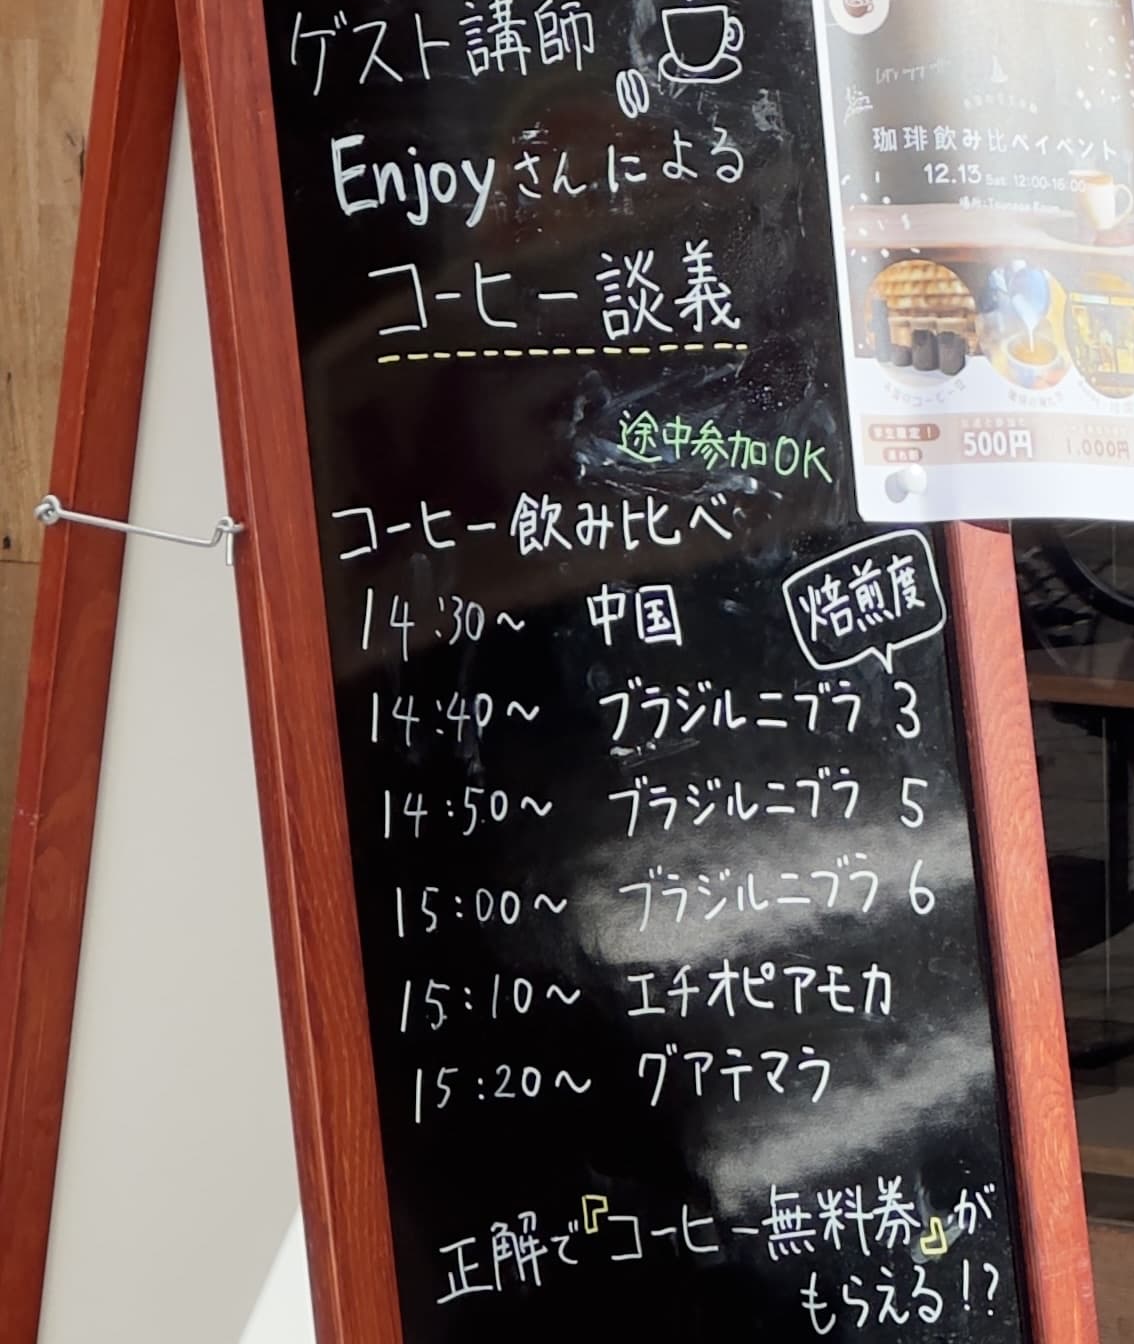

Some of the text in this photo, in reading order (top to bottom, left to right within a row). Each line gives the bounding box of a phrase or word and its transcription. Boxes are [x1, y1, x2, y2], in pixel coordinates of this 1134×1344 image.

[871, 124, 1118, 161] 珈琲飲み比べイベント
[922, 162, 982, 185] 12.13
[331, 127, 743, 227] Enjoy さんによる
[368, 240, 740, 340] コーヒー談義
[616, 410, 833, 484] 途中参加OK
[962, 429, 1033, 458] 500円
[332, 493, 733, 559] コーヒー飲み比べ
[587, 584, 682, 646] 中国
[802, 553, 926, 642] 焙煎度
[599, 677, 860, 741] ブラジルニブラ
[894, 682, 920, 738] 3
[609, 767, 858, 836] ブラジルニブラ
[902, 778, 927, 827] 5
[620, 853, 878, 931] ブラジルニブラ
[910, 861, 934, 914] 6
[628, 961, 891, 1017] エチオピアモカ
[639, 1044, 830, 1106] グアテマラ
